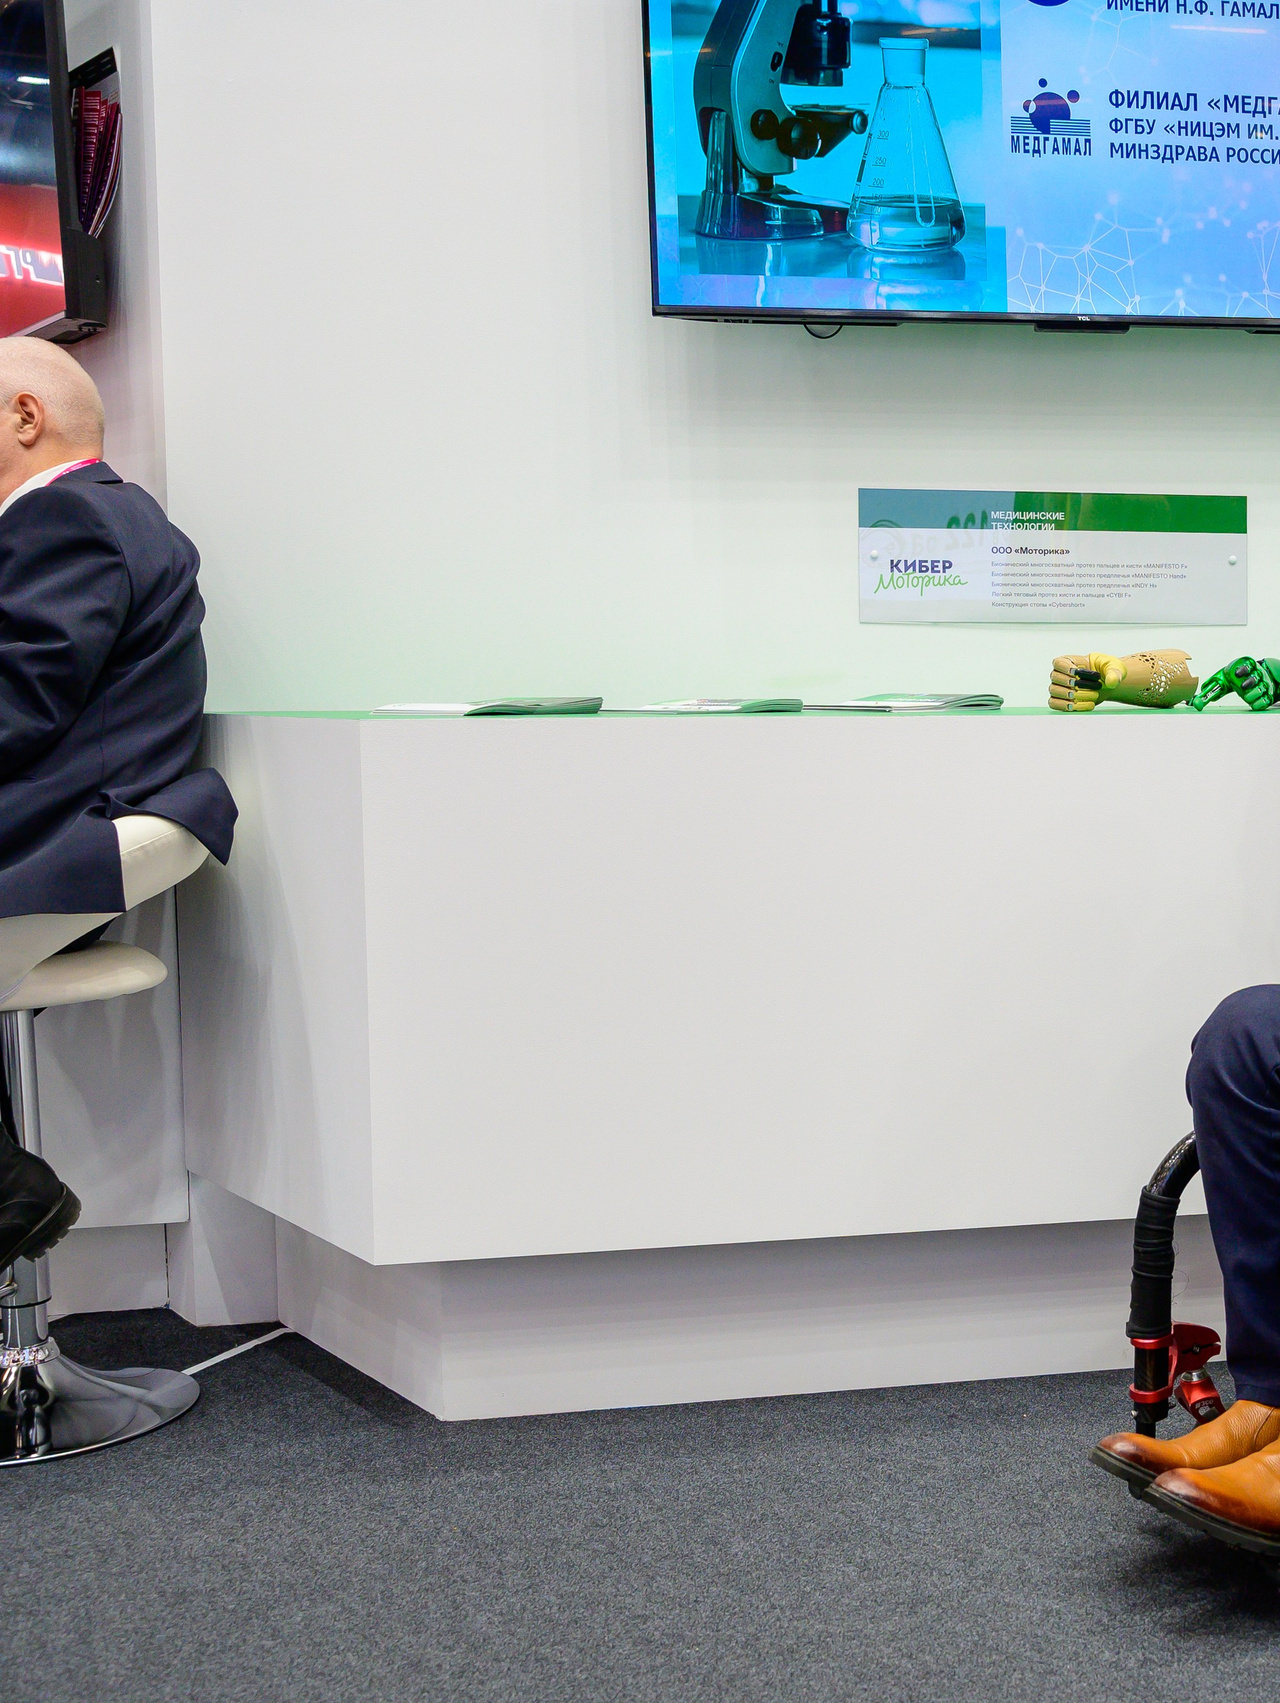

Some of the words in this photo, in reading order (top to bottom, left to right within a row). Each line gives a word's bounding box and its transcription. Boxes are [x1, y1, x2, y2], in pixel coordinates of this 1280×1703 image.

[1106, 0, 1169, 13] ИМЕНИ
[1176, 0, 1214, 16] Н.Ф.
[1108, 89, 1198, 112] ФИЛИАЛ
[1109, 118, 1156, 135] ФГБУ
[1163, 120, 1240, 141] «НИЦЭМ
[1247, 123, 1279, 140] ИМ.
[1010, 135, 1092, 158] МЕДГАМАЛ
[1109, 142, 1220, 164] МИНЗДРАВА
[991, 511, 1065, 521] МЕДИЦИНСКИЕ
[991, 522, 1055, 531] ТЕХНОЛОГИИ
[991, 546, 1012, 555] ООО
[1014, 547, 1070, 556] «Моторика»
[890, 559, 953, 573] КИБЕР
[873, 571, 968, 597] Моторика
